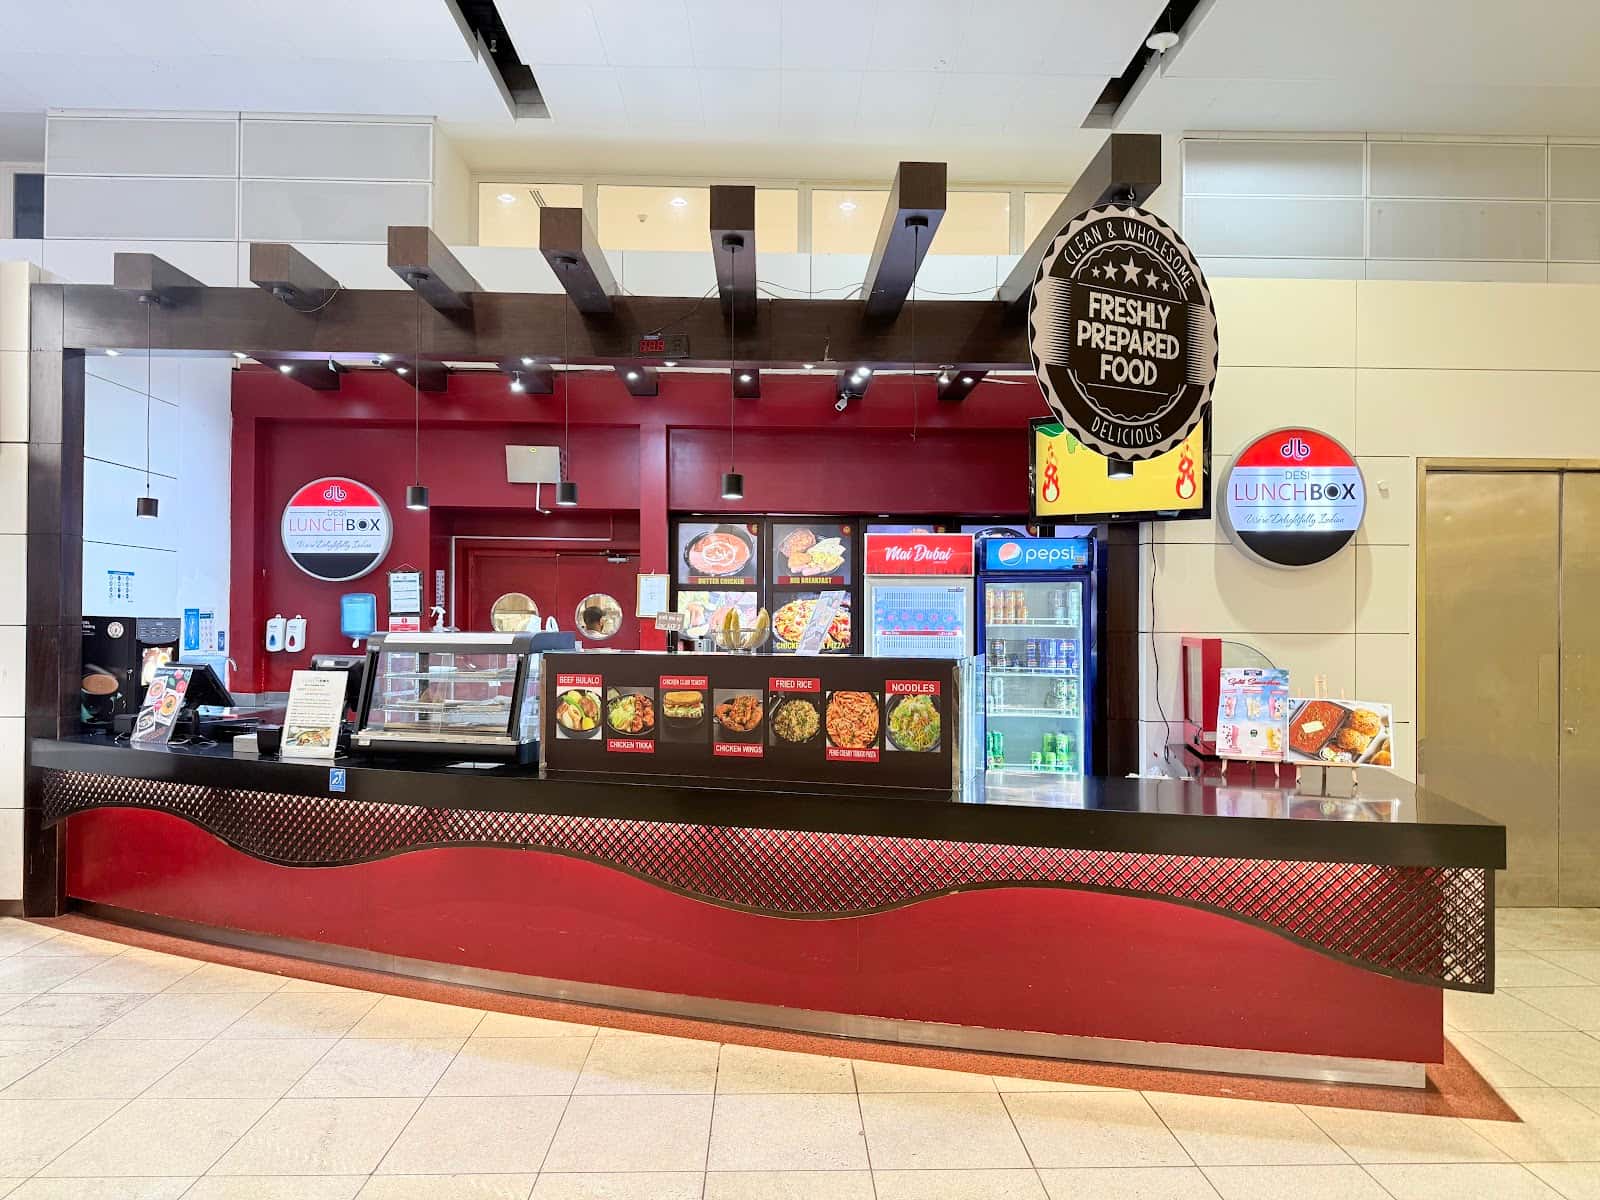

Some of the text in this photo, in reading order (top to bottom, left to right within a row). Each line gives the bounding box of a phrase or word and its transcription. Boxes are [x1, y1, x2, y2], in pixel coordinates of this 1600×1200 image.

[1064, 220, 1195, 289] CLEAN & WHOLESOME
[1088, 291, 1171, 330] FRESHLY
[1076, 320, 1180, 360] PREPARED
[1100, 354, 1158, 386] FOOD
[1091, 416, 1162, 446] DELICIOUS
[1284, 470, 1310, 480] DESI
[1233, 482, 1356, 501] LUNCHBOX
[289, 518, 381, 532] LUNCHBOX
[883, 544, 953, 562] Mai Dubai
[1025, 545, 1075, 563] pepsi
[559, 675, 600, 685] BEEF BULALO
[775, 680, 813, 689] FRIED RICE
[891, 683, 935, 693] NOODLES
[609, 740, 653, 750] CHICKEN TIKKA
[715, 744, 763, 754] CHICKEN WINGS
